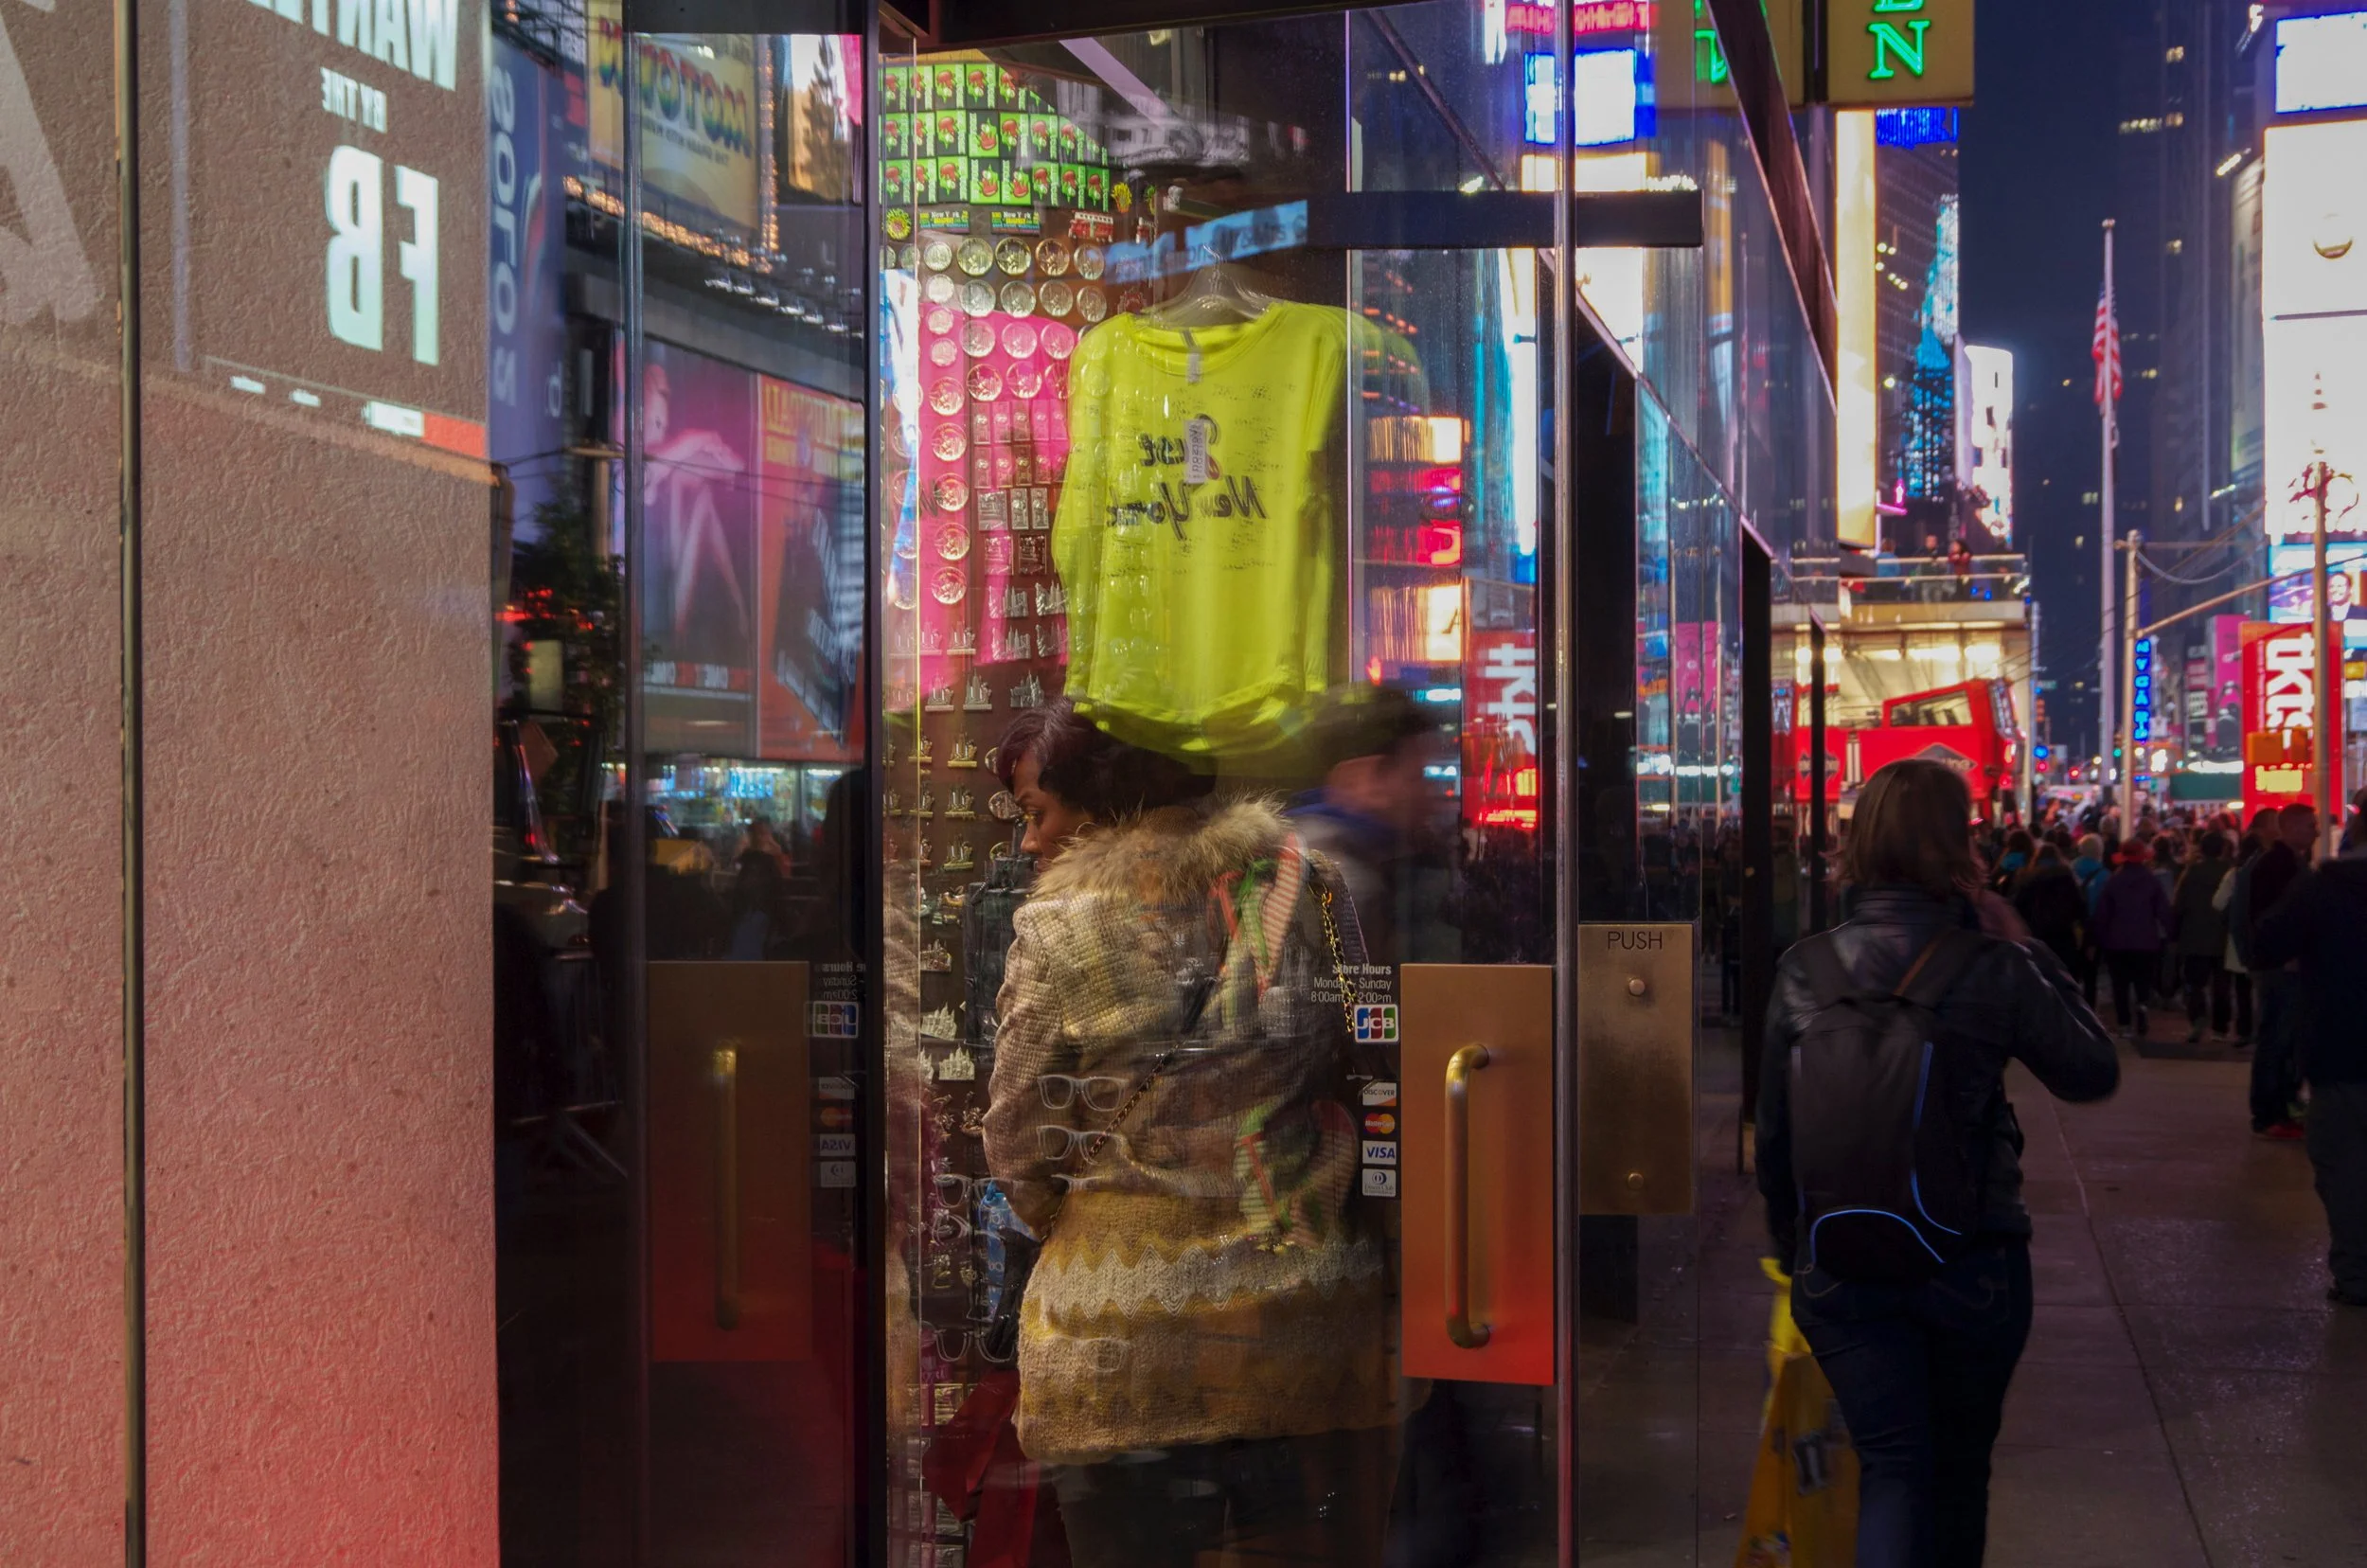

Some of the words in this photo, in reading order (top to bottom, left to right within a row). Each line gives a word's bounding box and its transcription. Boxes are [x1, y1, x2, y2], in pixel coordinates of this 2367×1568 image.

[1608, 931, 1663, 950] PUSH
[1362, 963, 1392, 974] Hours
[1359, 977, 1392, 991] Sunday
[1357, 1017, 1395, 1029] JCB
[1364, 1119, 1396, 1128] MasterCard
[1366, 1147, 1396, 1158] VISA
